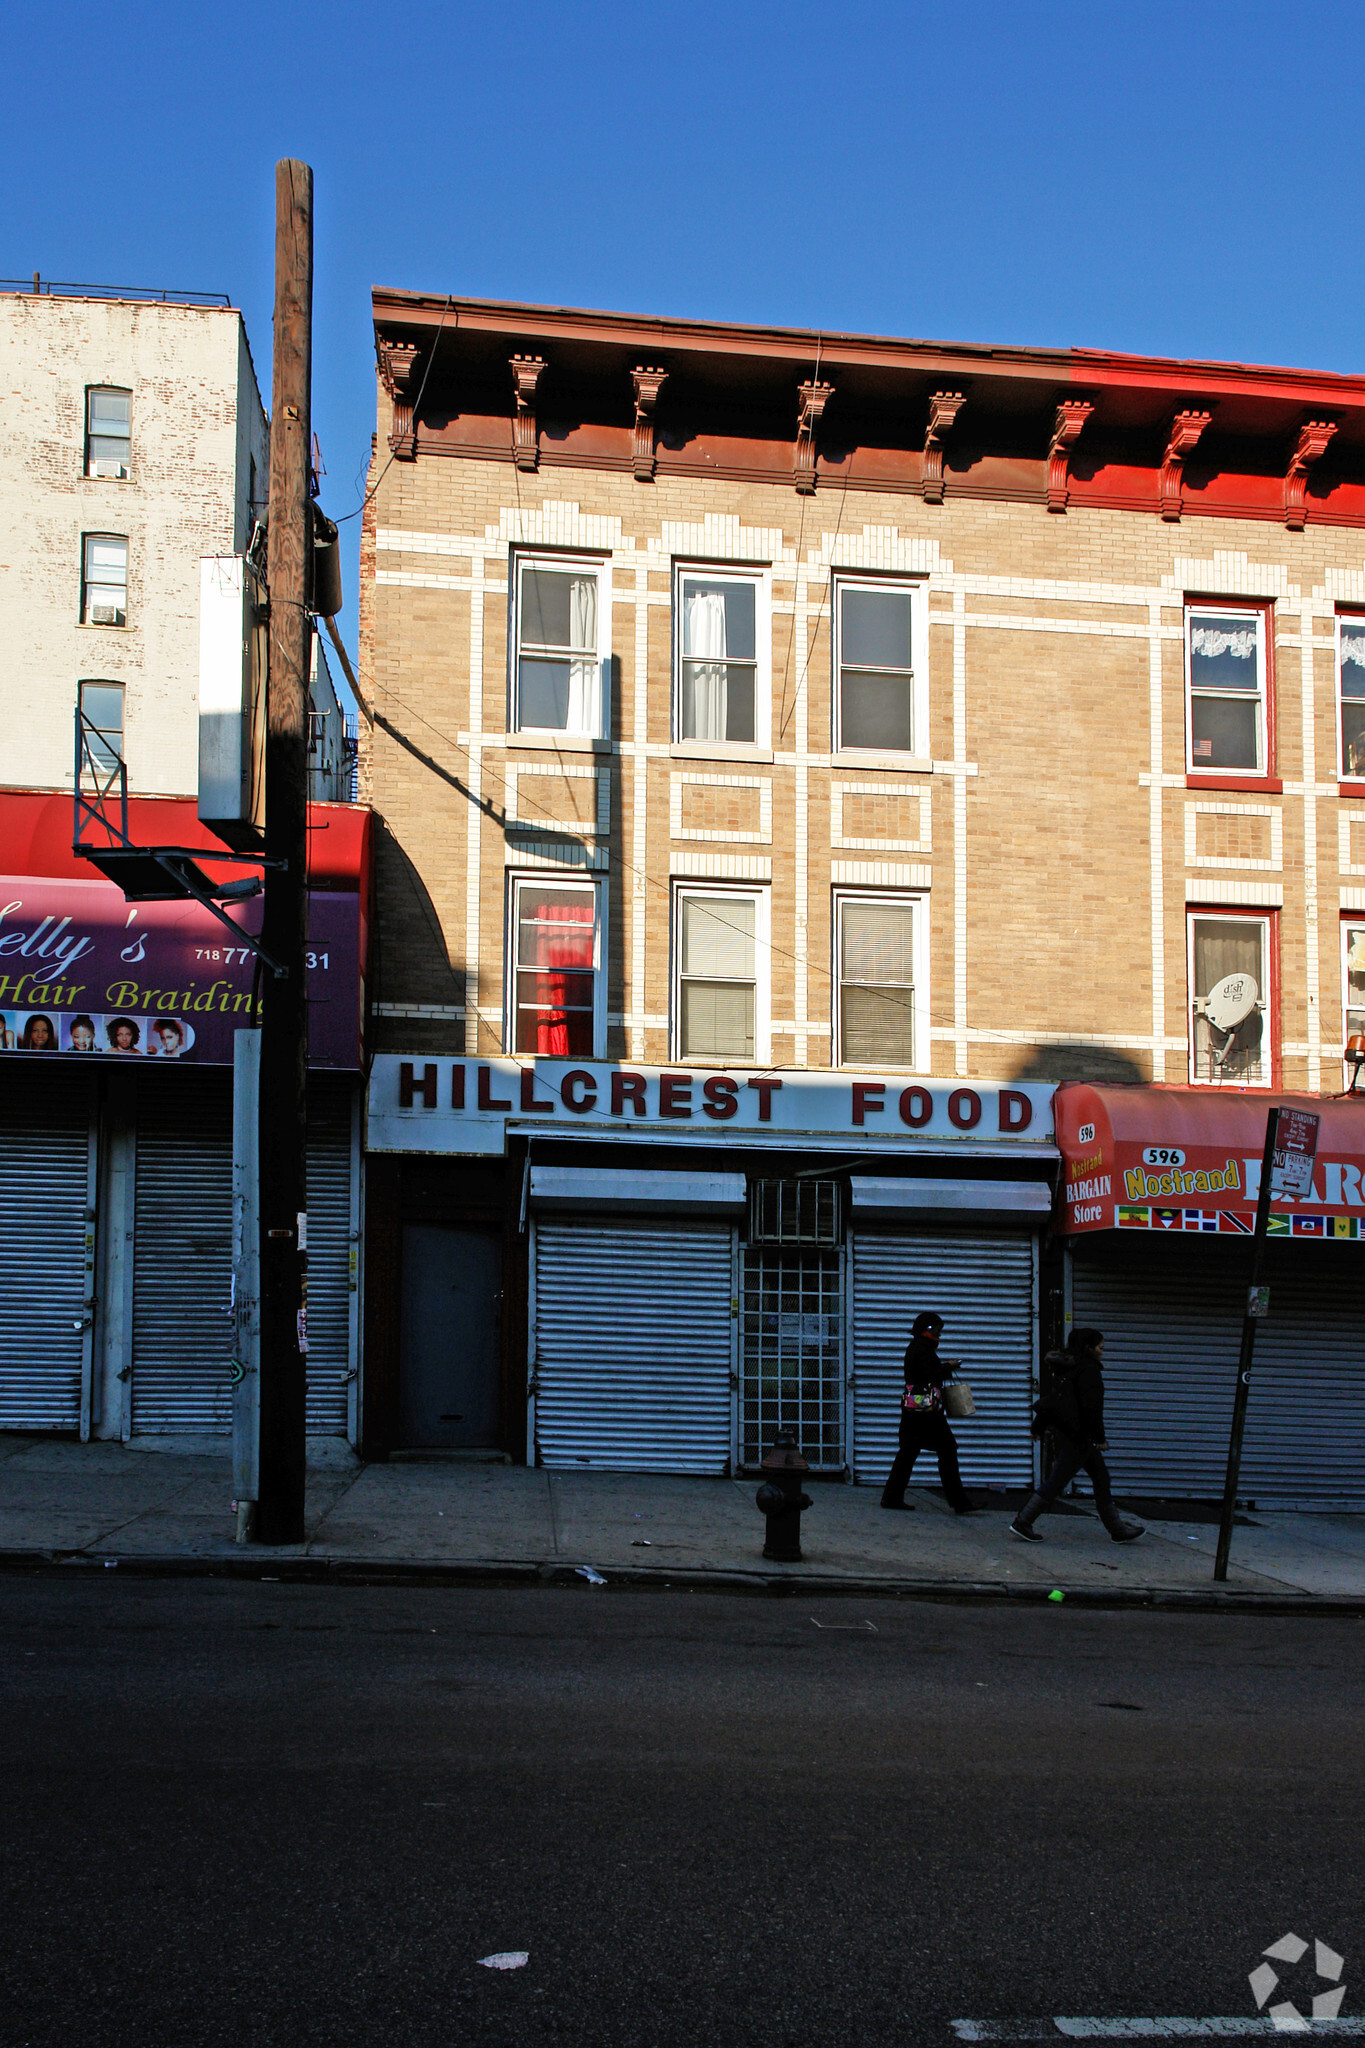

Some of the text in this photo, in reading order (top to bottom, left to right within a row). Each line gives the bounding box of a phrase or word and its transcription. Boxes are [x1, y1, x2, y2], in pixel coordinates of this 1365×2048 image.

[0, 974, 263, 1023] Hair Braidin
[400, 1062, 1032, 1132] HILLCREST FOOD
[1081, 1126, 1094, 1141] 596
[1072, 1147, 1102, 1180] Nostrand
[1149, 1150, 1179, 1164] 596
[1273, 1150, 1310, 1167] NO PARKING
[1066, 1175, 1111, 1203] BARGAIN
[1125, 1160, 1239, 1200] Nostrand
[1074, 1205, 1102, 1224] Store
